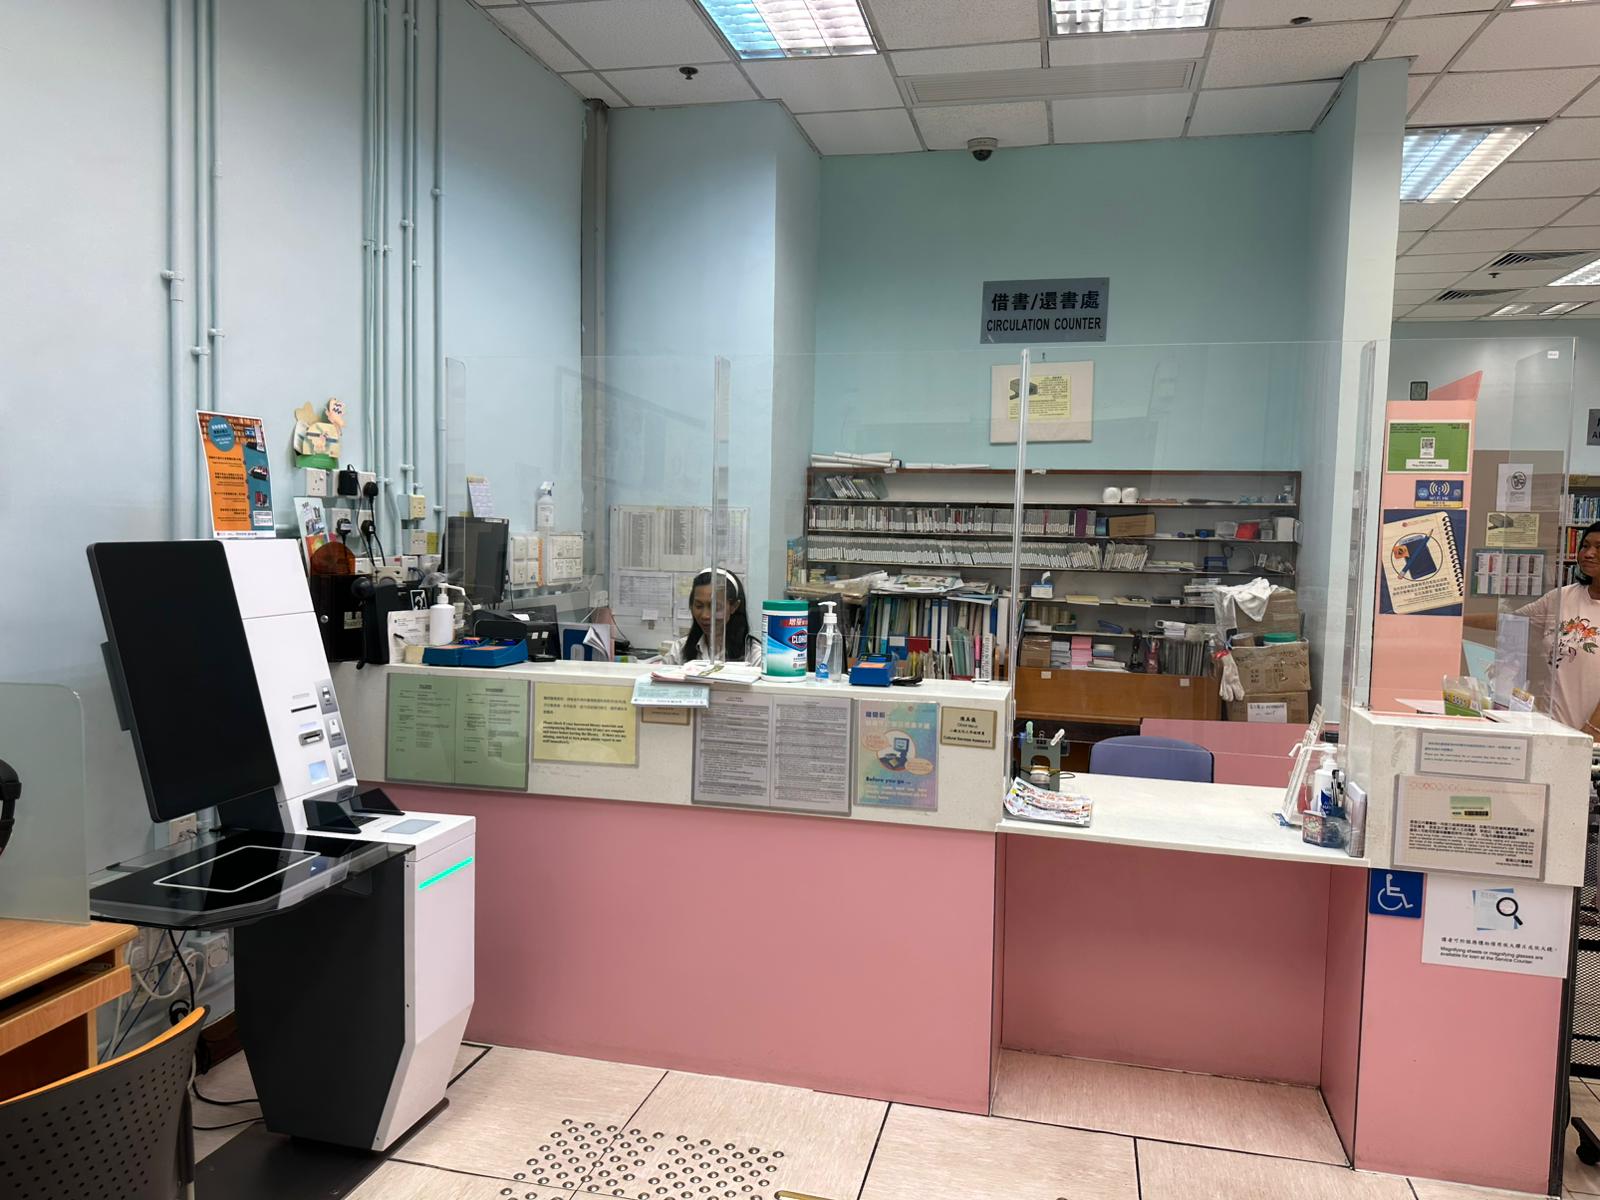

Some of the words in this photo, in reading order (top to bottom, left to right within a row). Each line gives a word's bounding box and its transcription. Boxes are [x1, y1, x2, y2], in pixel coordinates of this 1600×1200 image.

[992, 290, 1100, 311] 借書/還書處
[986, 318, 1050, 332] CIRCULATION
[1054, 317, 1102, 330] COUNTER
